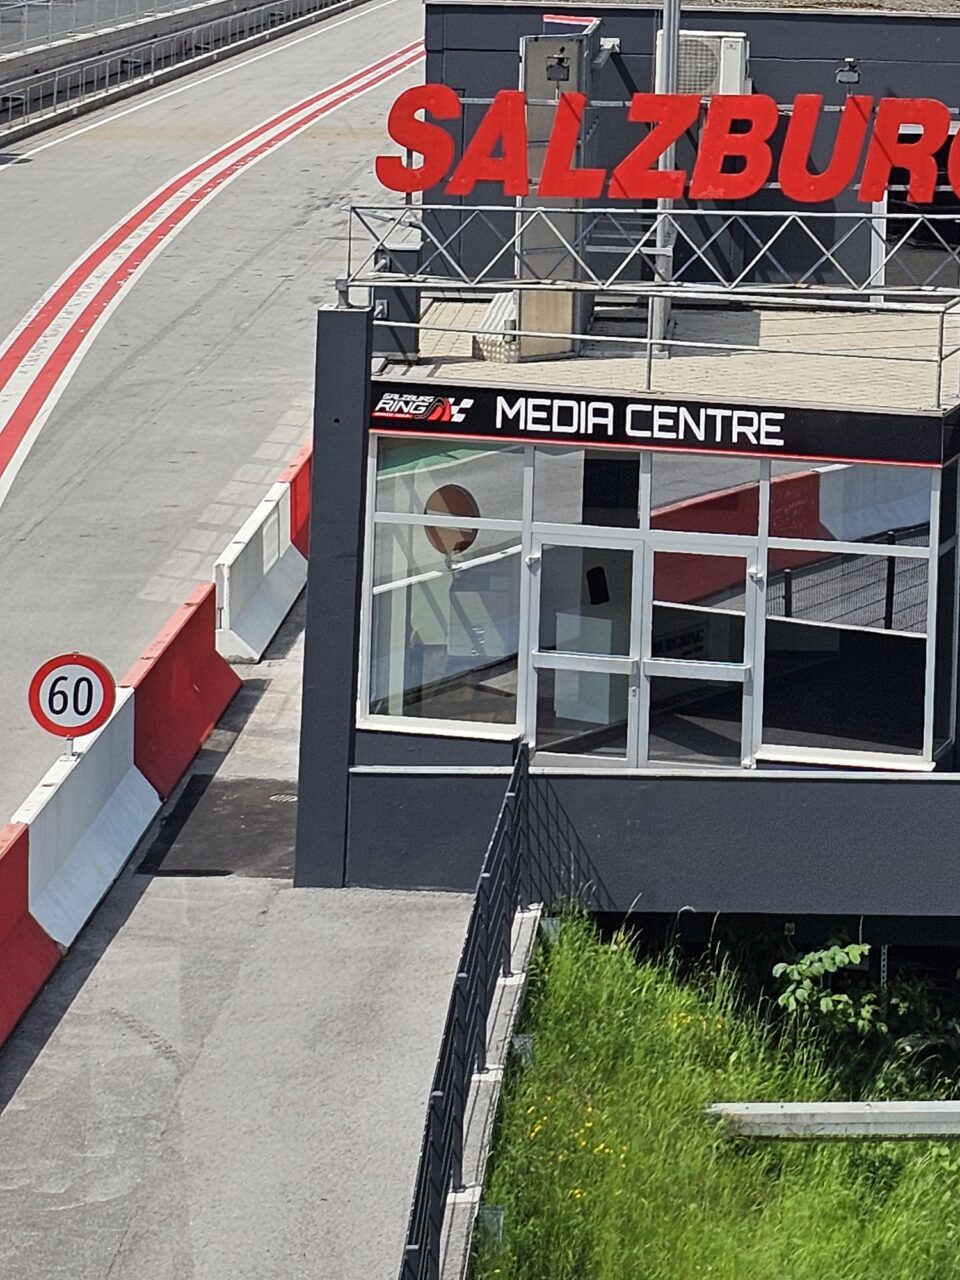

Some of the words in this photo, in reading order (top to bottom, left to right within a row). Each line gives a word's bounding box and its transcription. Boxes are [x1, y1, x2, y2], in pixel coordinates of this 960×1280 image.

[374, 400, 429, 414] RING
[495, 396, 614, 435] MEDIA
[625, 404, 785, 446] CENTRE
[48, 676, 94, 716] 60
